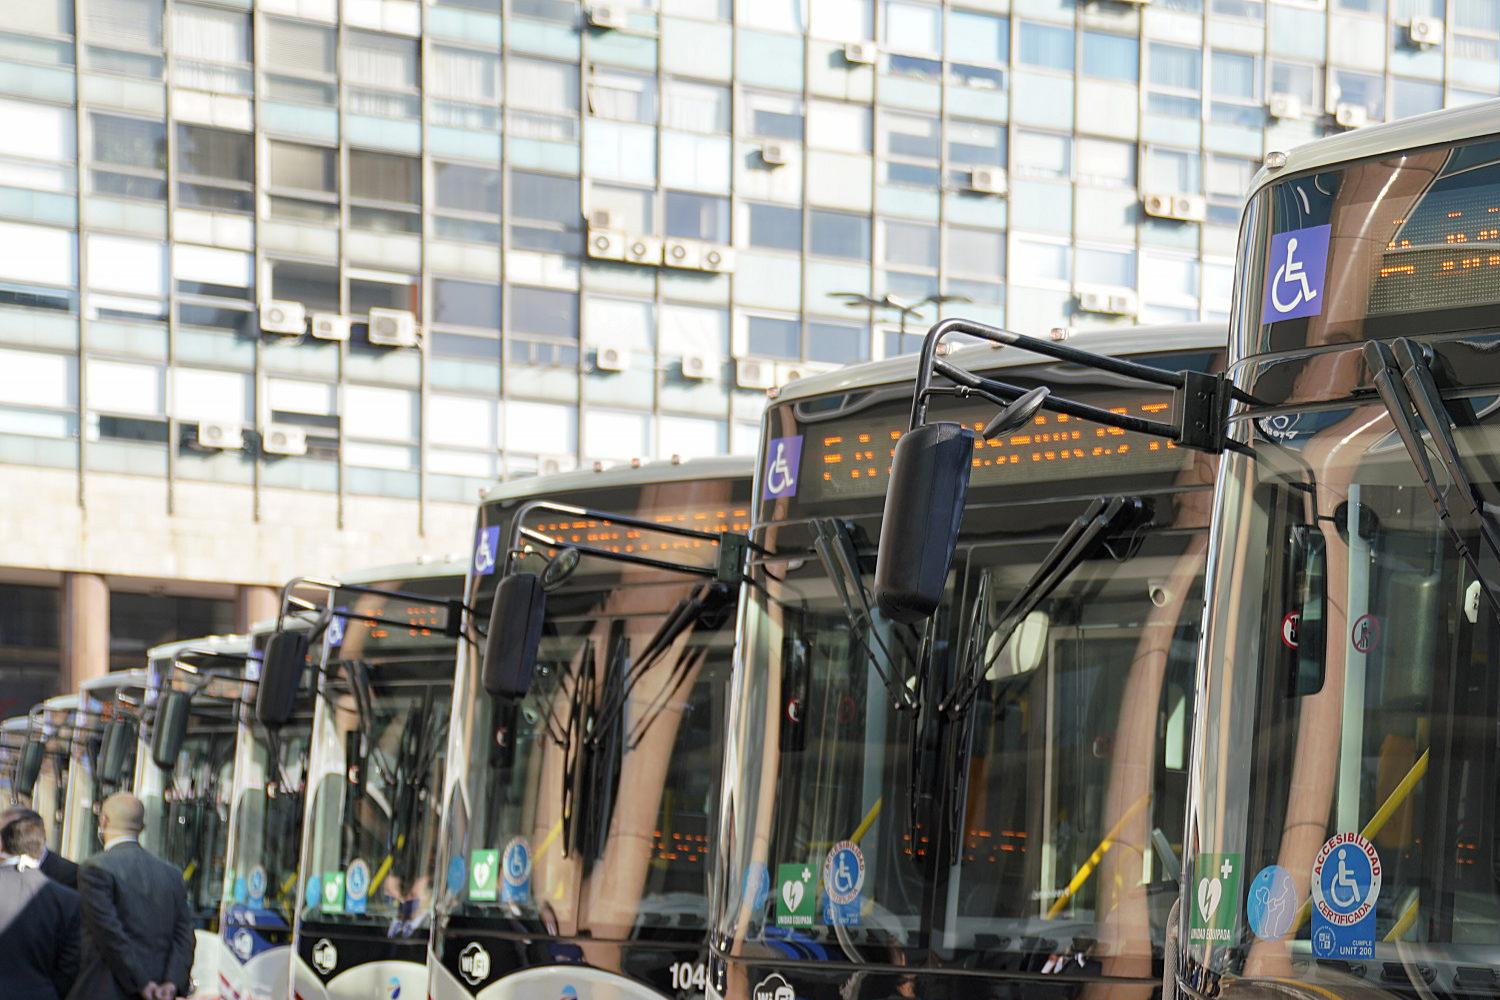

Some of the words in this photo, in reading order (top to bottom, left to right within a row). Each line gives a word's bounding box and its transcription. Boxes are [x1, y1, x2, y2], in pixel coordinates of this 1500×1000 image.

[1314, 831, 1381, 876] ACCESIBILIDAD
[1318, 901, 1372, 924] CERTIFICADA
[1339, 946, 1357, 956] UNIT
[1359, 947, 1372, 956] 200
[1352, 939, 1372, 947] CUMPLE
[669, 962, 705, 990] 104
